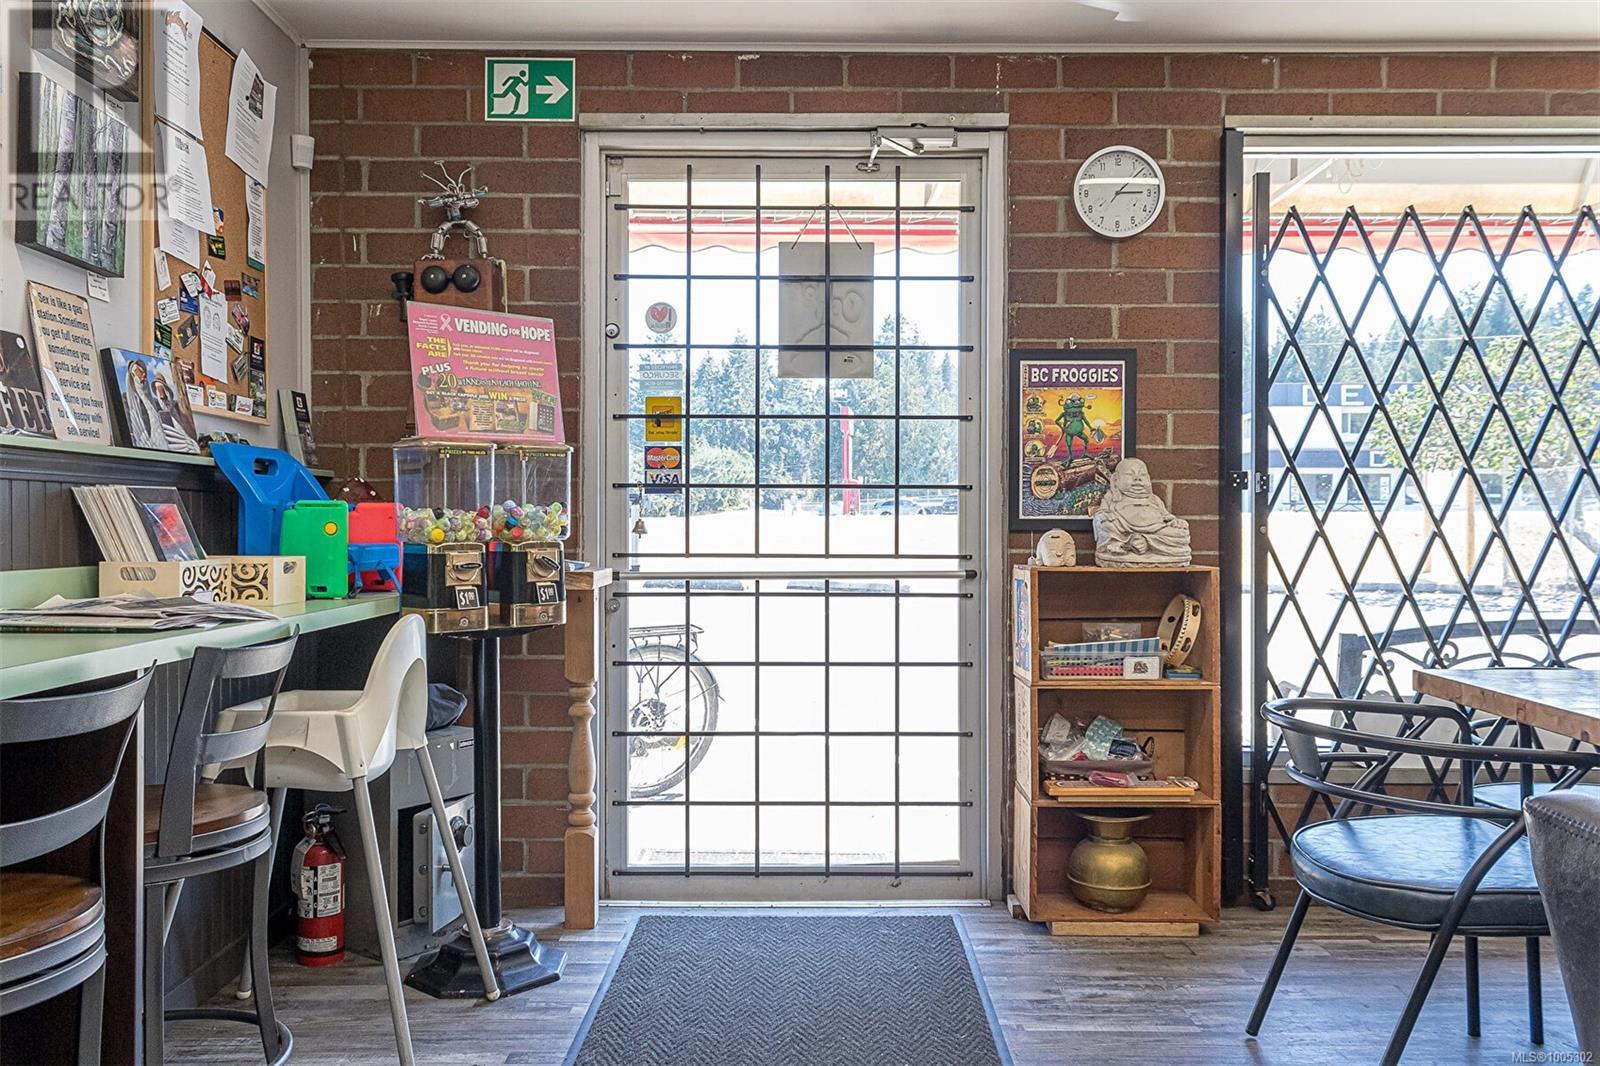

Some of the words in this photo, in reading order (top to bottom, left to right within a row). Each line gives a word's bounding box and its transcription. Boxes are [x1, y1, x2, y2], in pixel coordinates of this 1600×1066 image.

[1084, 190, 1089, 198] 9
[1147, 189, 1151, 197] 3
[1088, 205, 1093, 213] 8
[1142, 204, 1147, 212] 4
[1100, 216, 1104, 224] 7
[38, 292, 49, 304] Sex
[50, 296, 56, 306] is
[56, 297, 67, 309] like
[72, 304, 83, 315] gas
[51, 328, 61, 340] get
[61, 329, 71, 341] full
[454, 317, 509, 337] VENDING
[521, 325, 551, 342] HOPE
[416, 341, 447, 351] FACTS
[427, 336, 447, 344] THE
[48, 344, 80, 359] sometimes
[80, 350, 90, 361] you
[427, 350, 448, 358] ARE
[55, 361, 70, 372] gotta
[70, 363, 80, 374] ask
[81, 364, 90, 375] for
[421, 362, 451, 375] PLUS
[1031, 367, 1049, 382] BC
[1051, 367, 1119, 382] FROGGIES
[60, 377, 80, 389] service
[80, 382, 91, 391] and
[439, 373, 457, 389] 20
[80, 397, 90, 408] you
[90, 396, 103, 408] have
[489, 391, 508, 401] WIN
[73, 409, 91, 424] happy
[650, 474, 680, 485] VISA
